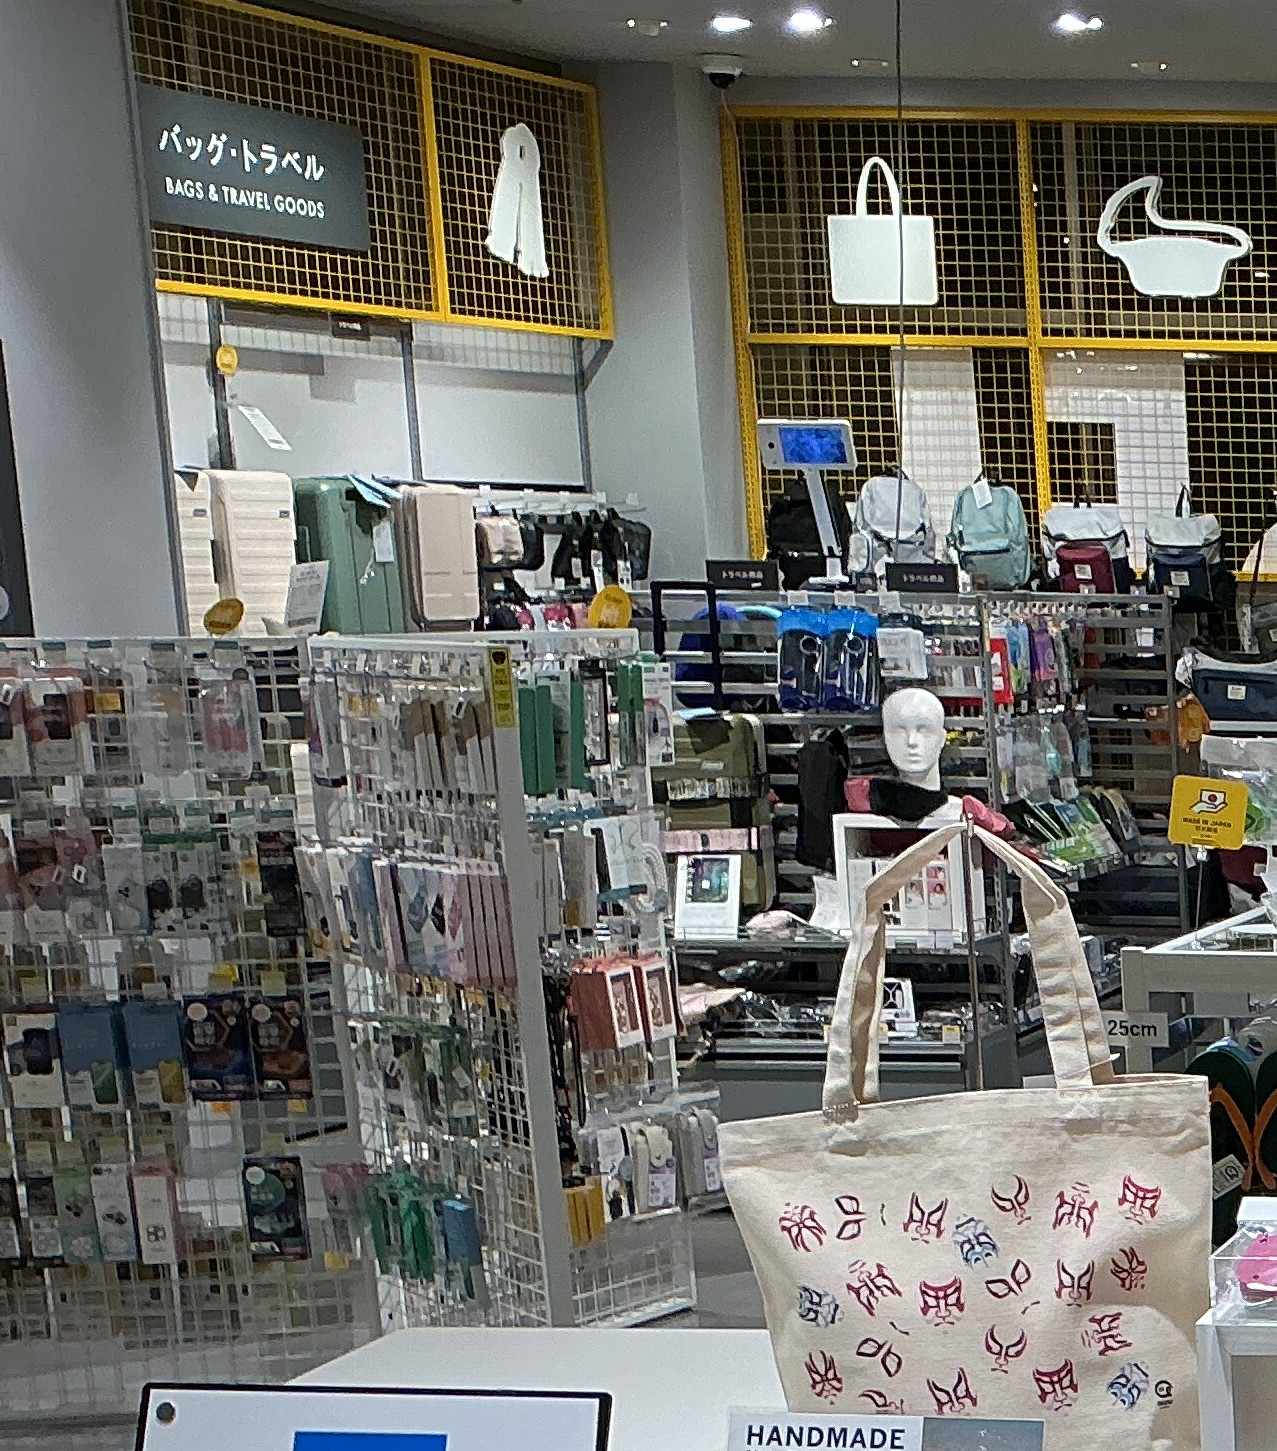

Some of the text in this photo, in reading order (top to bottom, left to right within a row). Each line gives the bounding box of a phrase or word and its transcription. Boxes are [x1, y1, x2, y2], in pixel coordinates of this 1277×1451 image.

[159, 123, 326, 182] バッグ・トラベル
[164, 176, 326, 219] BAGS & TRAVEL GOODS
[1107, 1019, 1158, 1037] 25cm
[746, 1424, 906, 1450] HANDMADE
